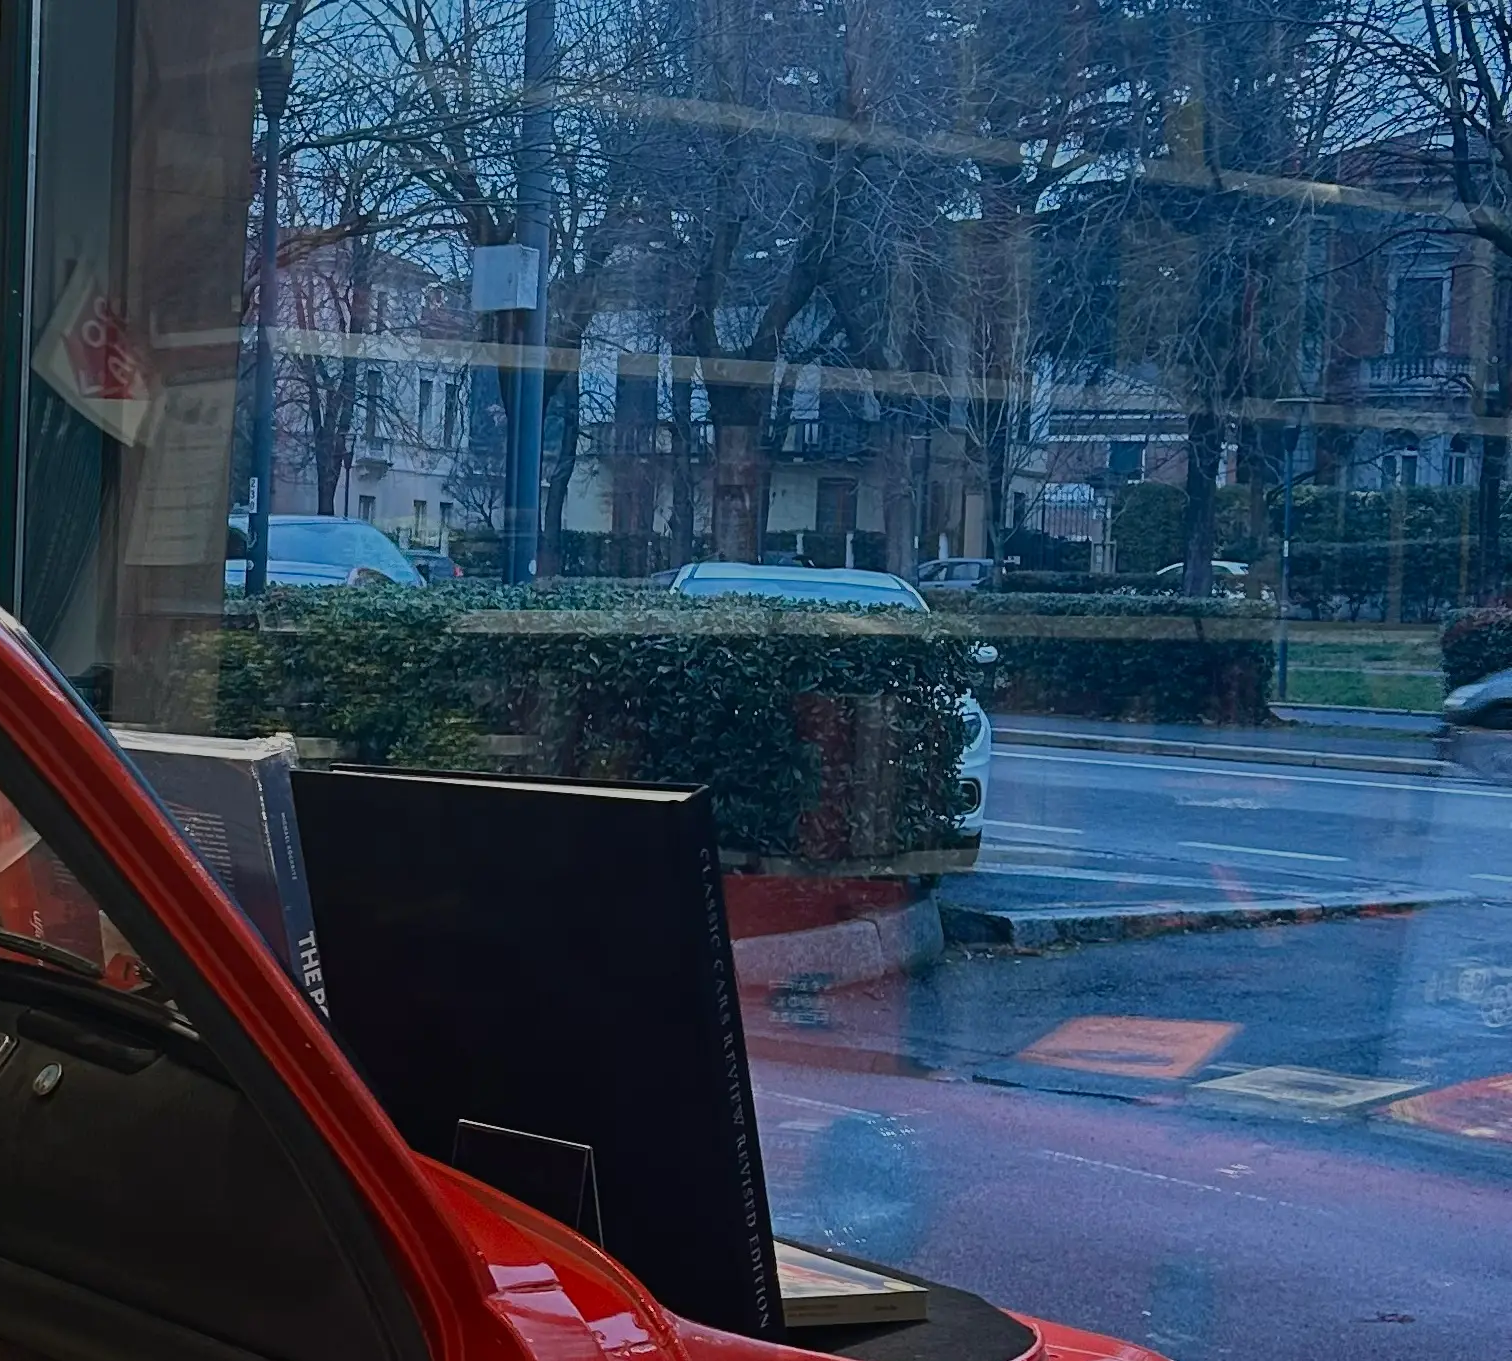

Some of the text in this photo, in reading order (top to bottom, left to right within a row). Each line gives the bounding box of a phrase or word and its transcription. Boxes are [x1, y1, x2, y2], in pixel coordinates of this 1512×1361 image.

[297, 930, 323, 987] THE
[699, 847, 771, 1329] CLASSIC CARS REVIEW REVISED EDITION
